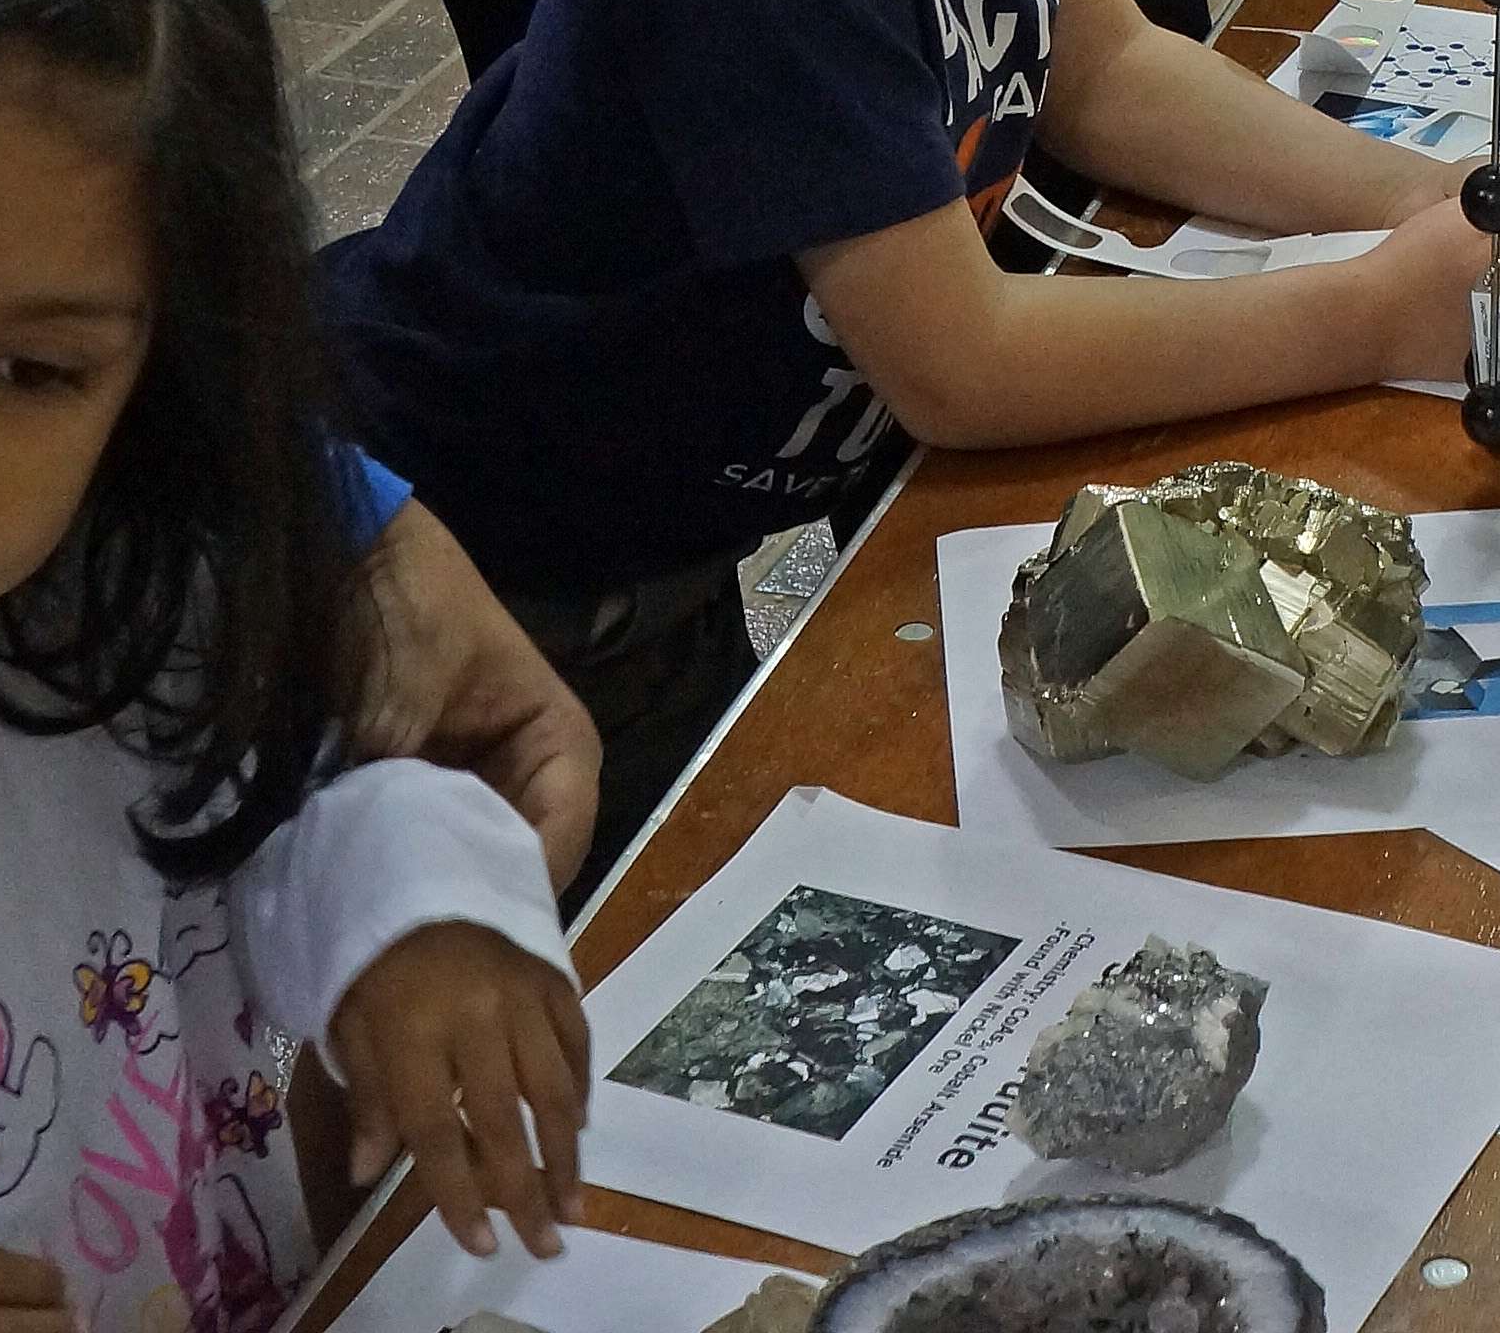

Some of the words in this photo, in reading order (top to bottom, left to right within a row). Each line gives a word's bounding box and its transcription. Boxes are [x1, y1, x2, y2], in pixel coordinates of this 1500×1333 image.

[1023, 926, 1072, 971] Found
[997, 970, 1031, 1004] with
[954, 1000, 1005, 1048] Nickel
[927, 1048, 962, 1078] Ore
[936, 1053, 989, 1101] Cobalt
[875, 1100, 946, 1169] Arsenide
